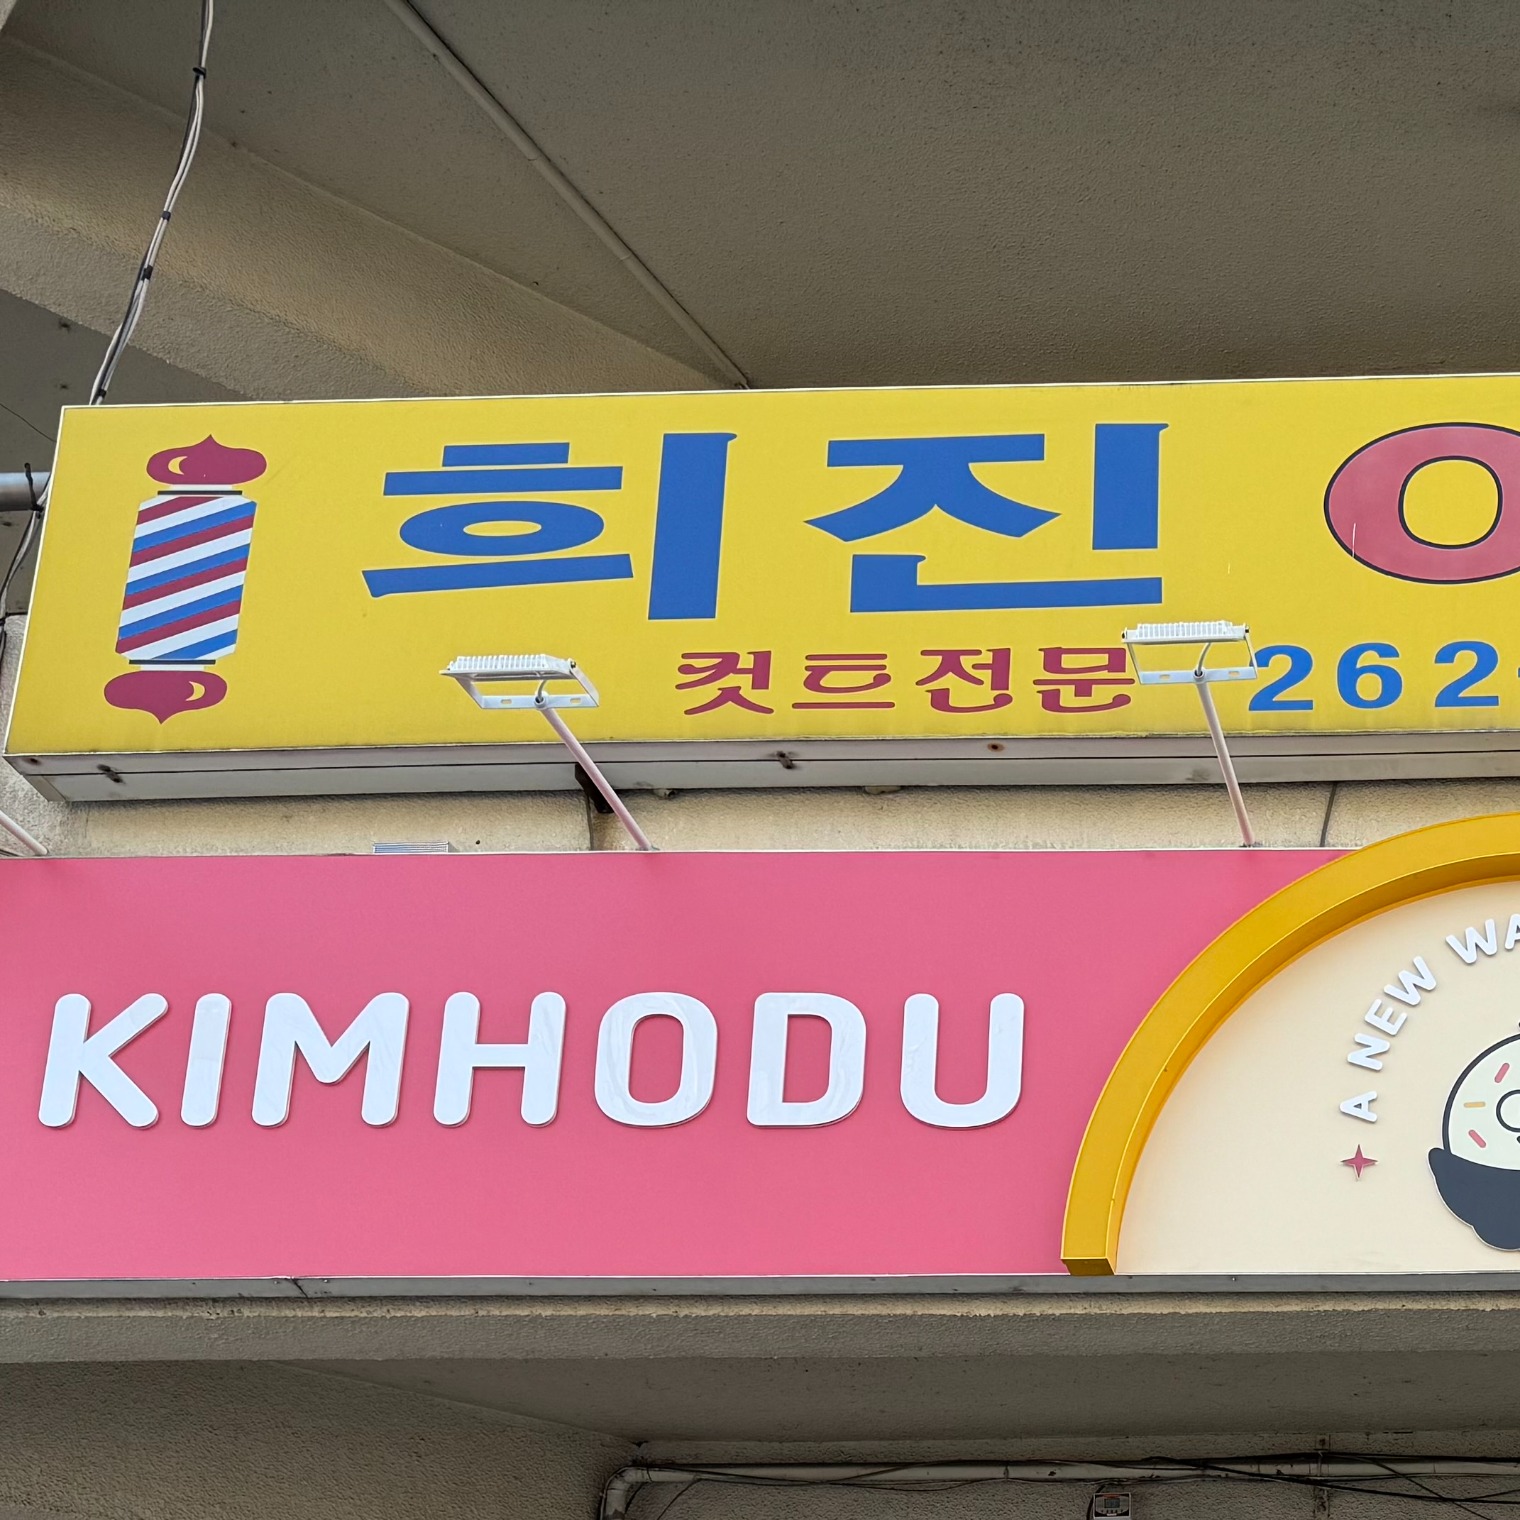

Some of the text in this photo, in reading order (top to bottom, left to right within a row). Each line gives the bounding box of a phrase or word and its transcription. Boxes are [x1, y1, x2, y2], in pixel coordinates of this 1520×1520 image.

[362, 421, 1170, 620] 희진
[38, 991, 1025, 1129] KIMHODU
[1347, 955, 1438, 1072] NEW
[1340, 1090, 1379, 1122] A
